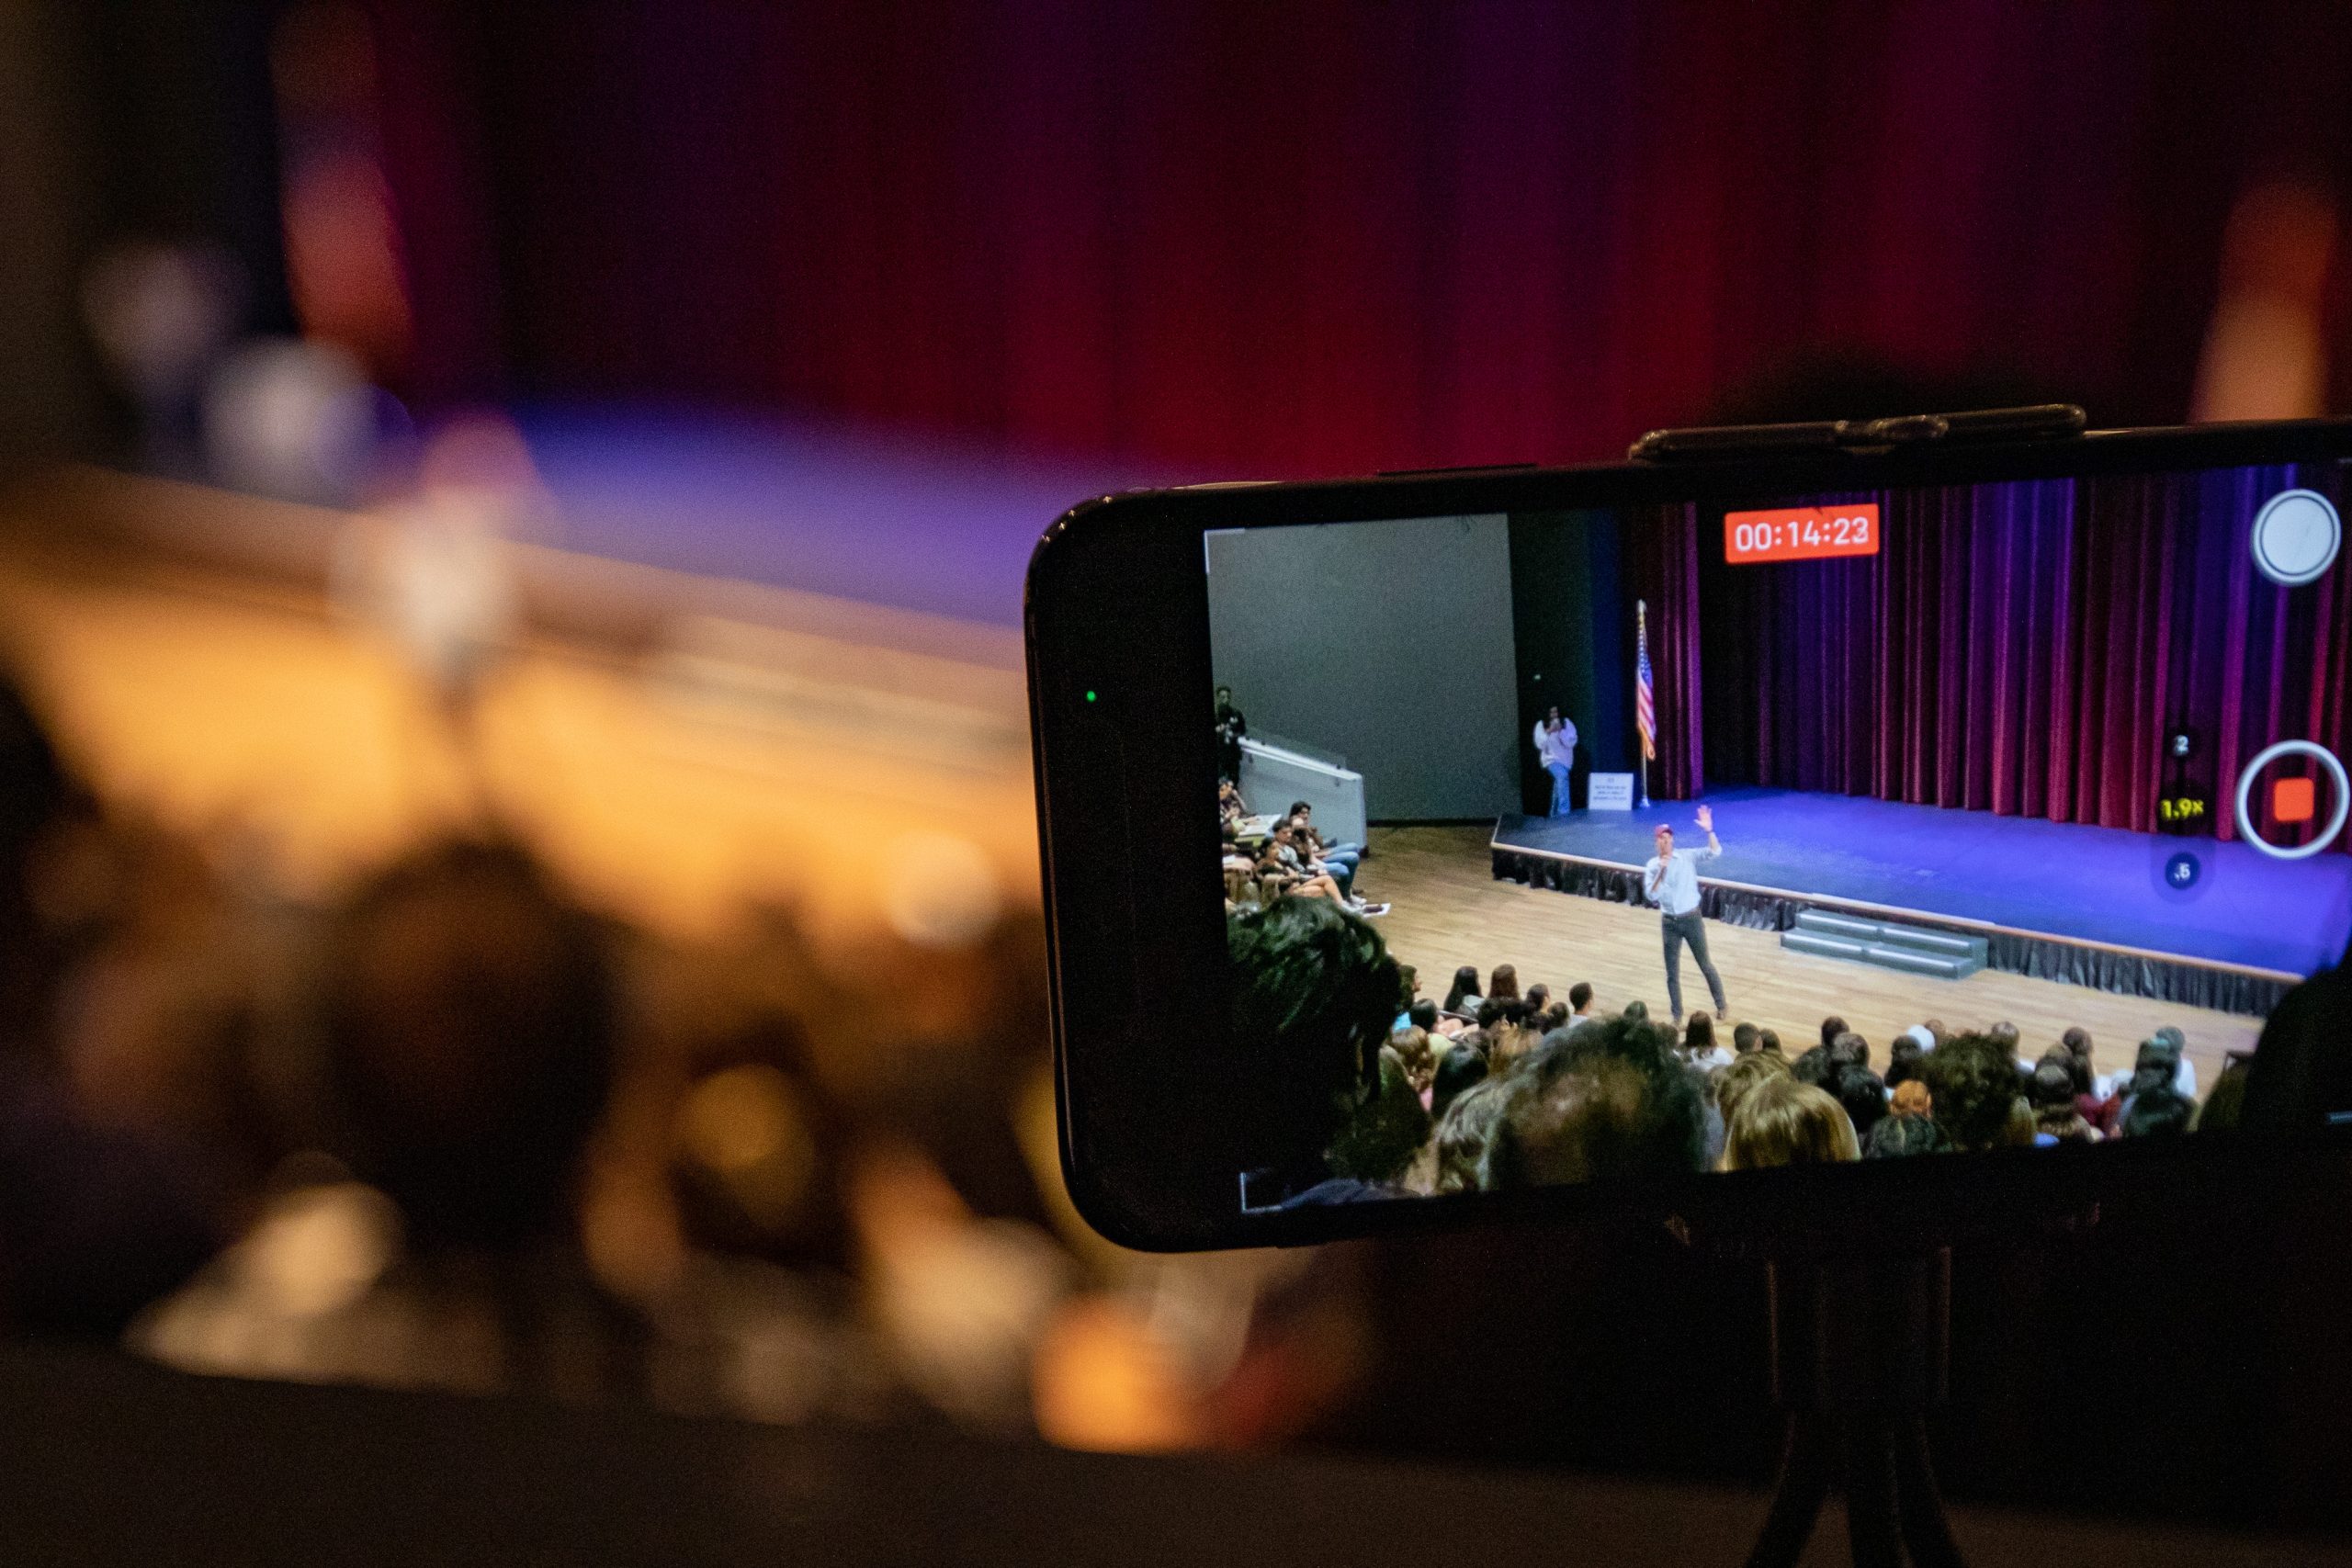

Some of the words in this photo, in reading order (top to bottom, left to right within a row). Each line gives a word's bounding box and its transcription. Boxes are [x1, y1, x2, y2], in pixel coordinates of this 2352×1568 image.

[1735, 516, 1870, 552] 00:14:23
[2173, 735, 2189, 756] 2
[2174, 863, 2191, 881] .5
